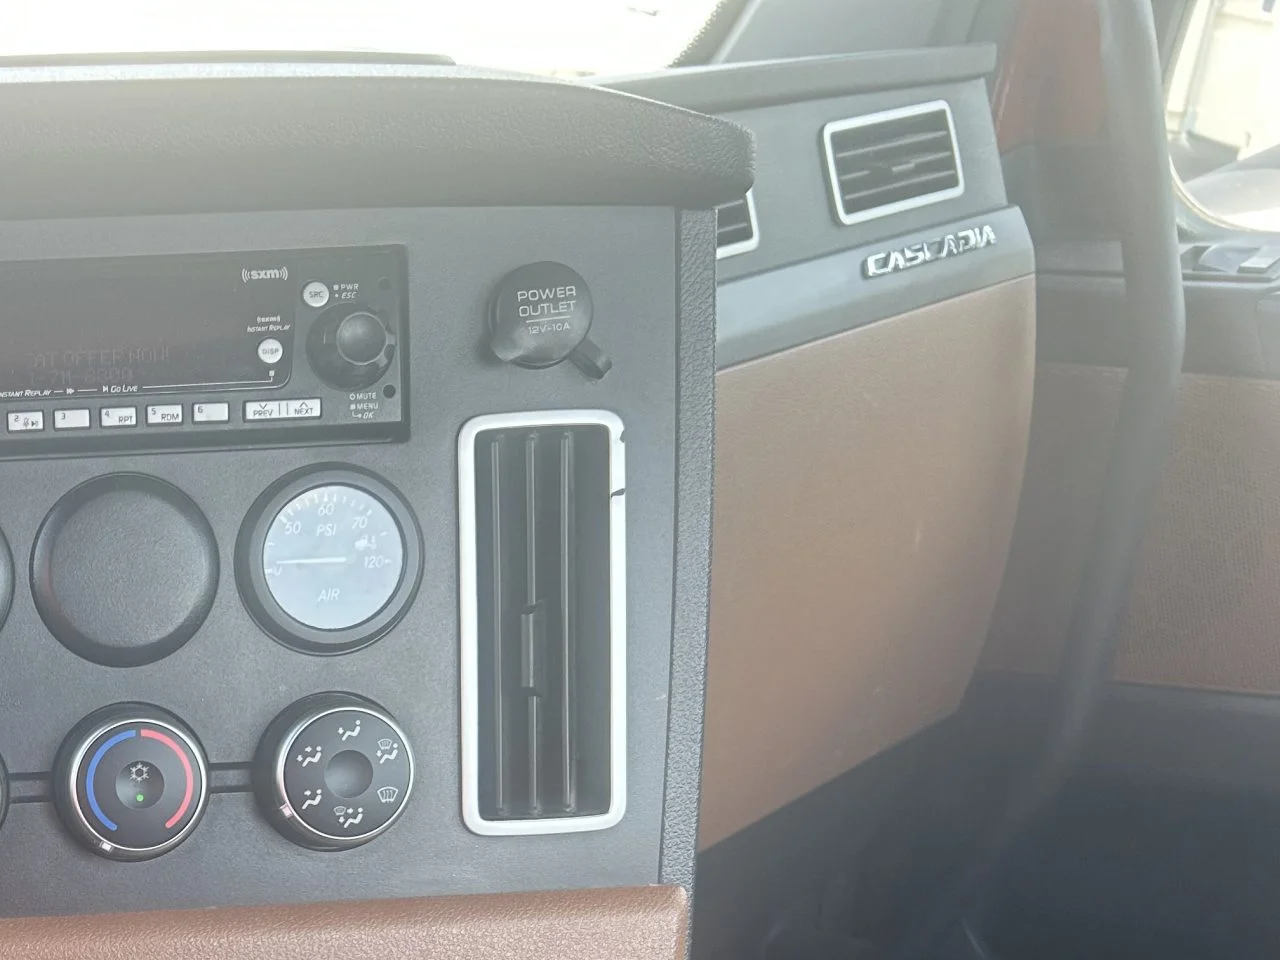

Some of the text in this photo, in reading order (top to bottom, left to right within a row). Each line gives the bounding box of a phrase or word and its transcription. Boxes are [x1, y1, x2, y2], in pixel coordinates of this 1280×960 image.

[866, 224, 997, 276] CASCADIA
[308, 290, 324, 298] SRC
[341, 291, 357, 299] ESC
[517, 285, 577, 302] POWER
[518, 300, 577, 317] OUTLET
[528, 322, 570, 334] 12V-10A
[262, 347, 279, 355] DISP
[24, 389, 52, 397] REPLAY
[356, 392, 377, 400] MUTE
[197, 406, 204, 414] 6
[356, 402, 379, 410] MENU
[104, 410, 110, 418] 4
[151, 407, 157, 416] 5
[253, 409, 273, 417] PREV
[294, 407, 314, 415] NEXT
[363, 411, 375, 419] OK
[14, 414, 21, 423] 2
[60, 412, 66, 420] 3
[118, 415, 133, 424] RPT
[160, 413, 180, 422] RDM
[317, 503, 335, 517] 60
[351, 516, 368, 530] 70
[284, 521, 302, 535] 50
[316, 523, 337, 537] PSI
[364, 556, 384, 569] 120
[317, 589, 340, 601] AIR
